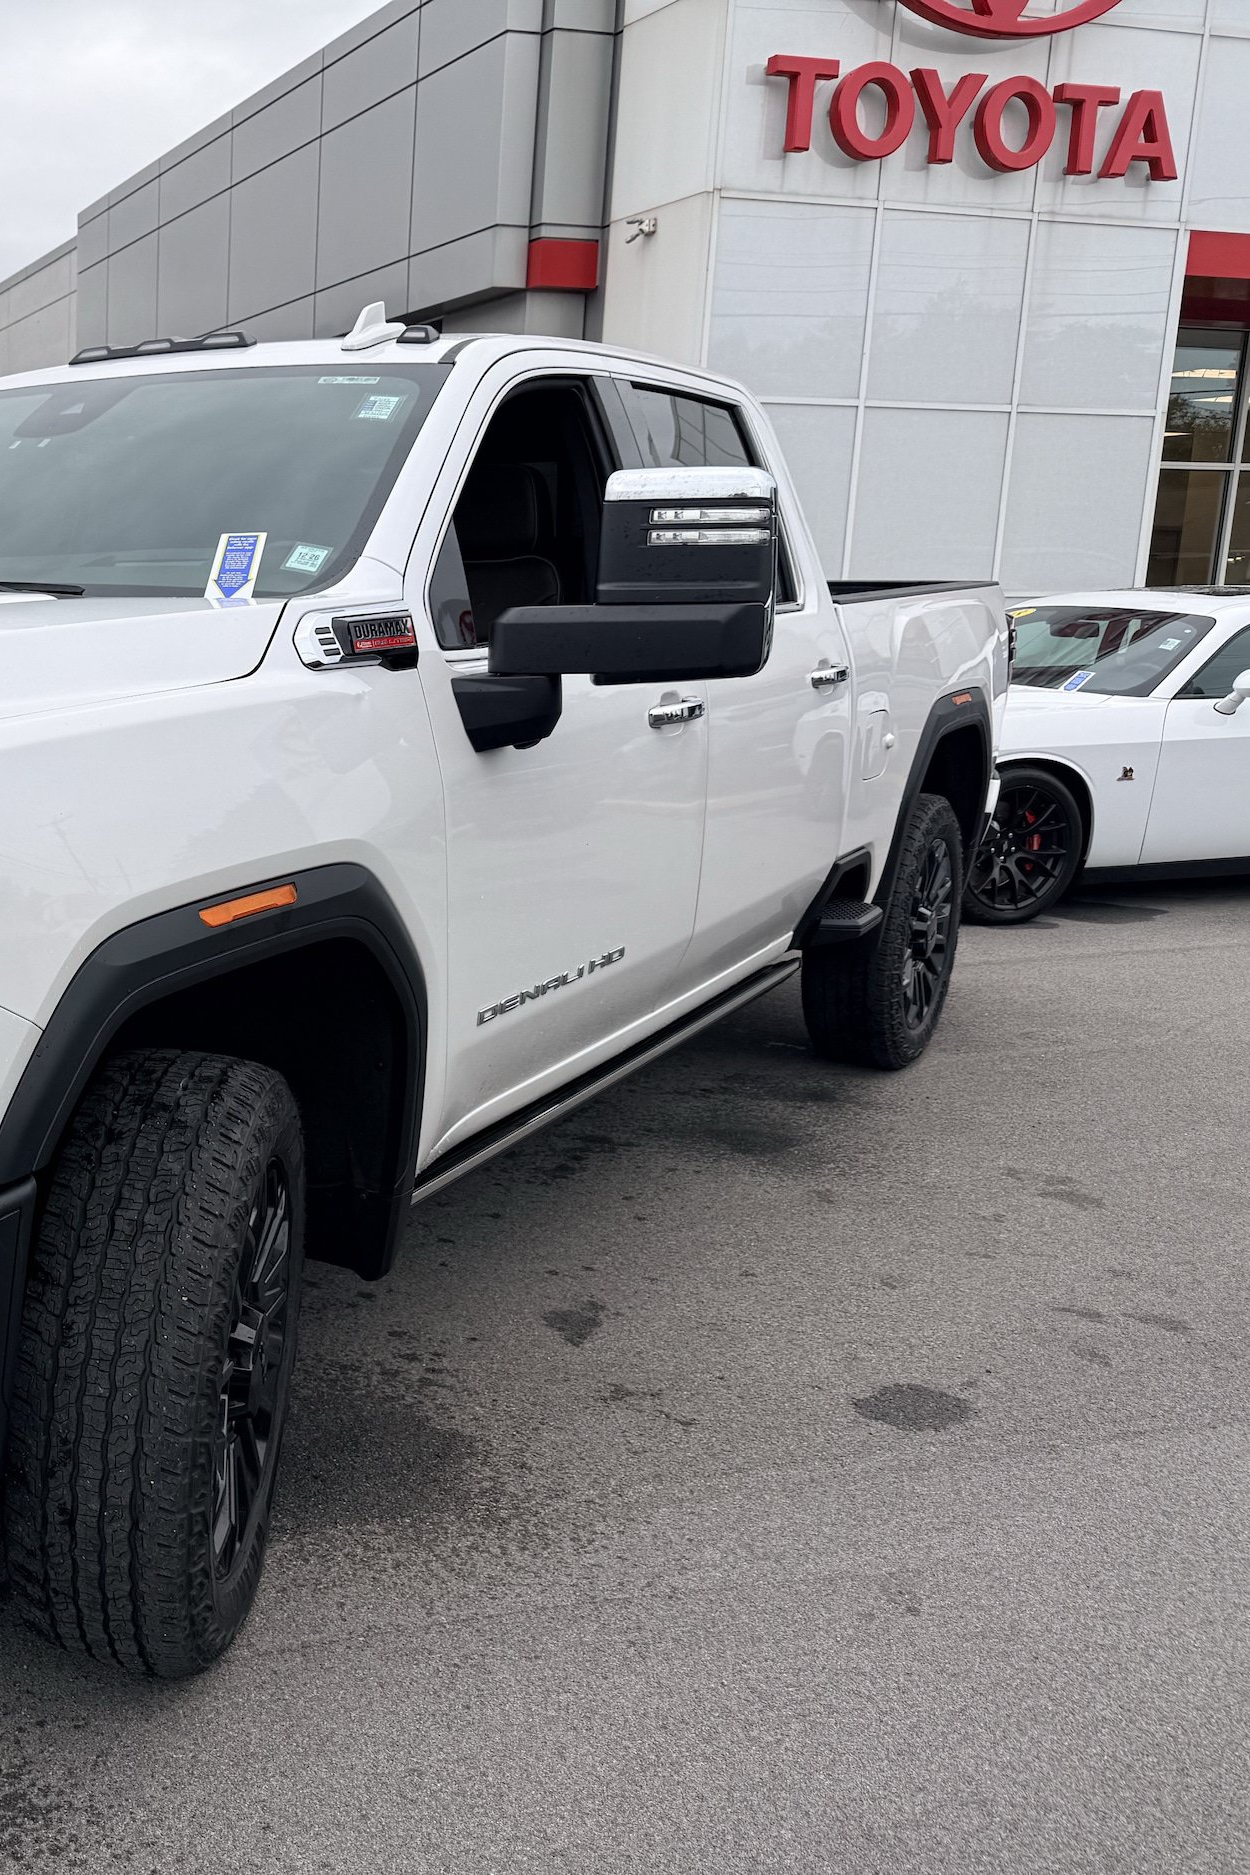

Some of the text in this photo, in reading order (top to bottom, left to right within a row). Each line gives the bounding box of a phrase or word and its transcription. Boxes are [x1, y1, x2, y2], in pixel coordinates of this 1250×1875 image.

[766, 54, 1178, 182] TOYOTA
[353, 618, 411, 639] DURAMAX
[477, 945, 625, 1027] DENALI HD
